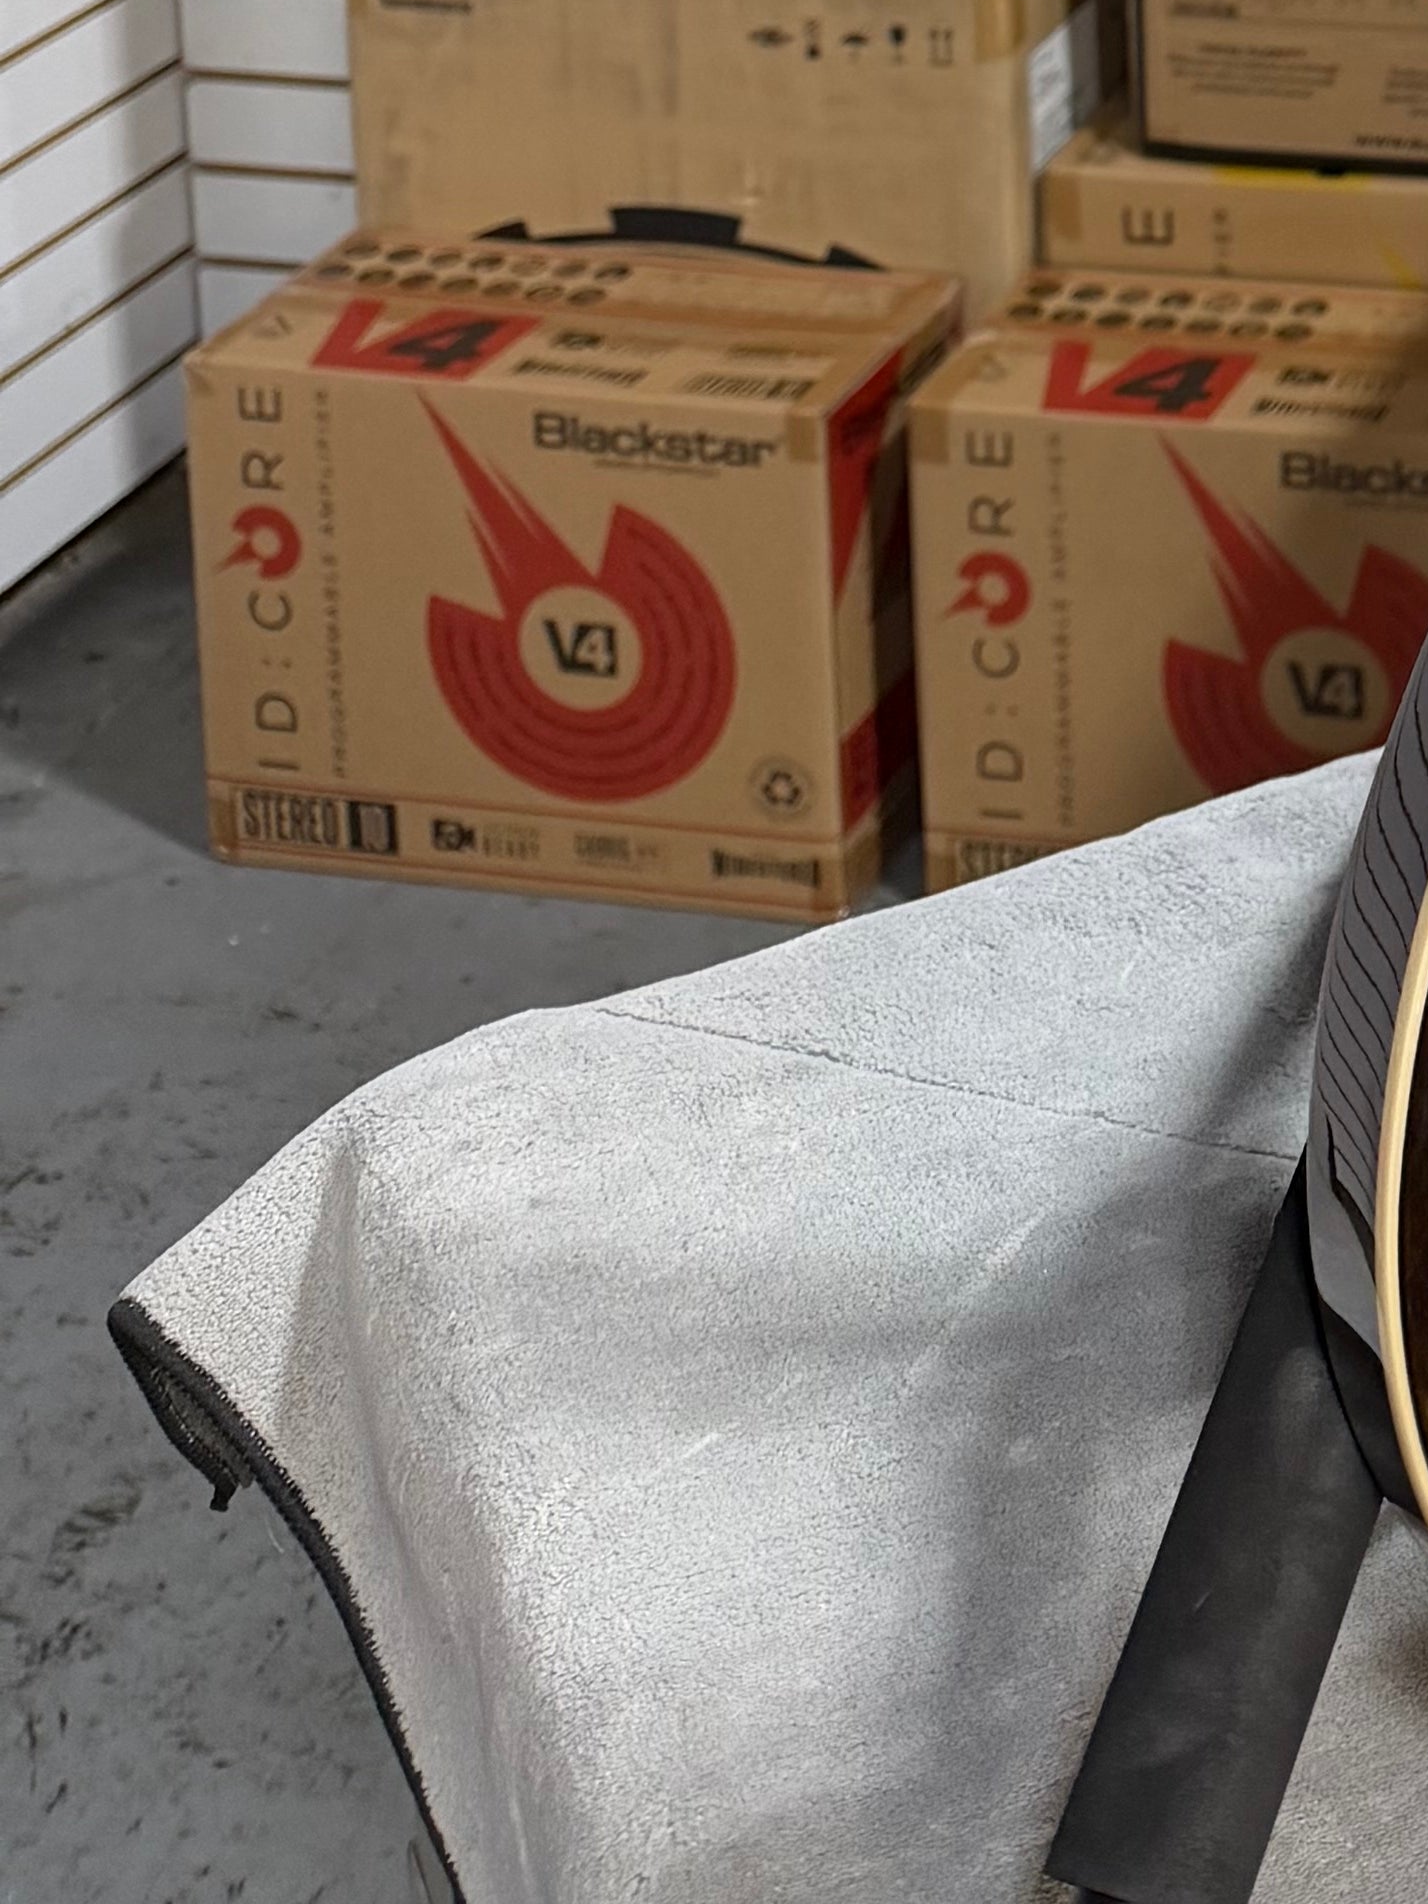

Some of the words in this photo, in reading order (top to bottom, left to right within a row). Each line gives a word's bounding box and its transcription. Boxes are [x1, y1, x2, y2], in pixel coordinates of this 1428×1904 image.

[533, 408, 778, 468] Blackstar
[544, 618, 618, 679] V4
[1287, 660, 1364, 720] V4
[242, 793, 340, 849] STEREO
